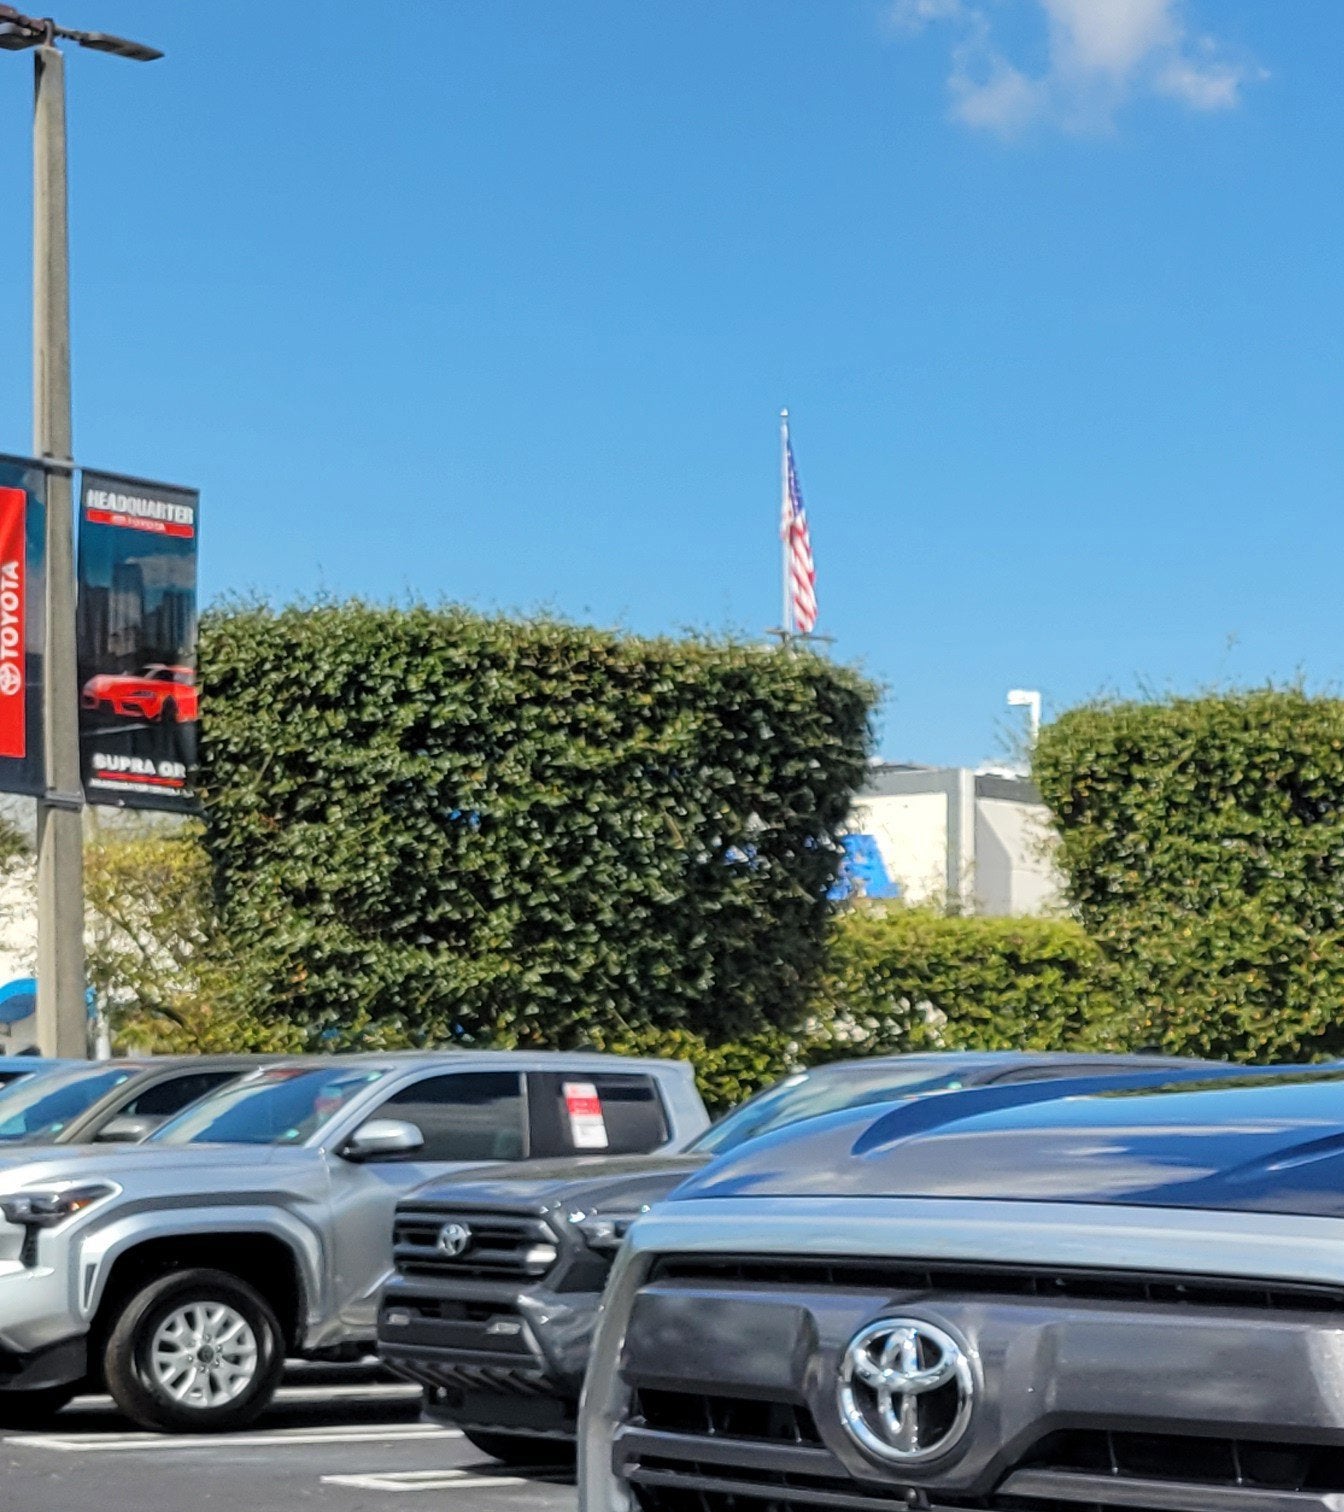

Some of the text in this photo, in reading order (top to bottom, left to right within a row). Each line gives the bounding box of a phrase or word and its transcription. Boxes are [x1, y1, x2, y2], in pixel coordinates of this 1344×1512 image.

[86, 488, 194, 525] HEADQUARTER
[0, 560, 20, 661] TOYOTA
[93, 752, 156, 775] SUPRA
